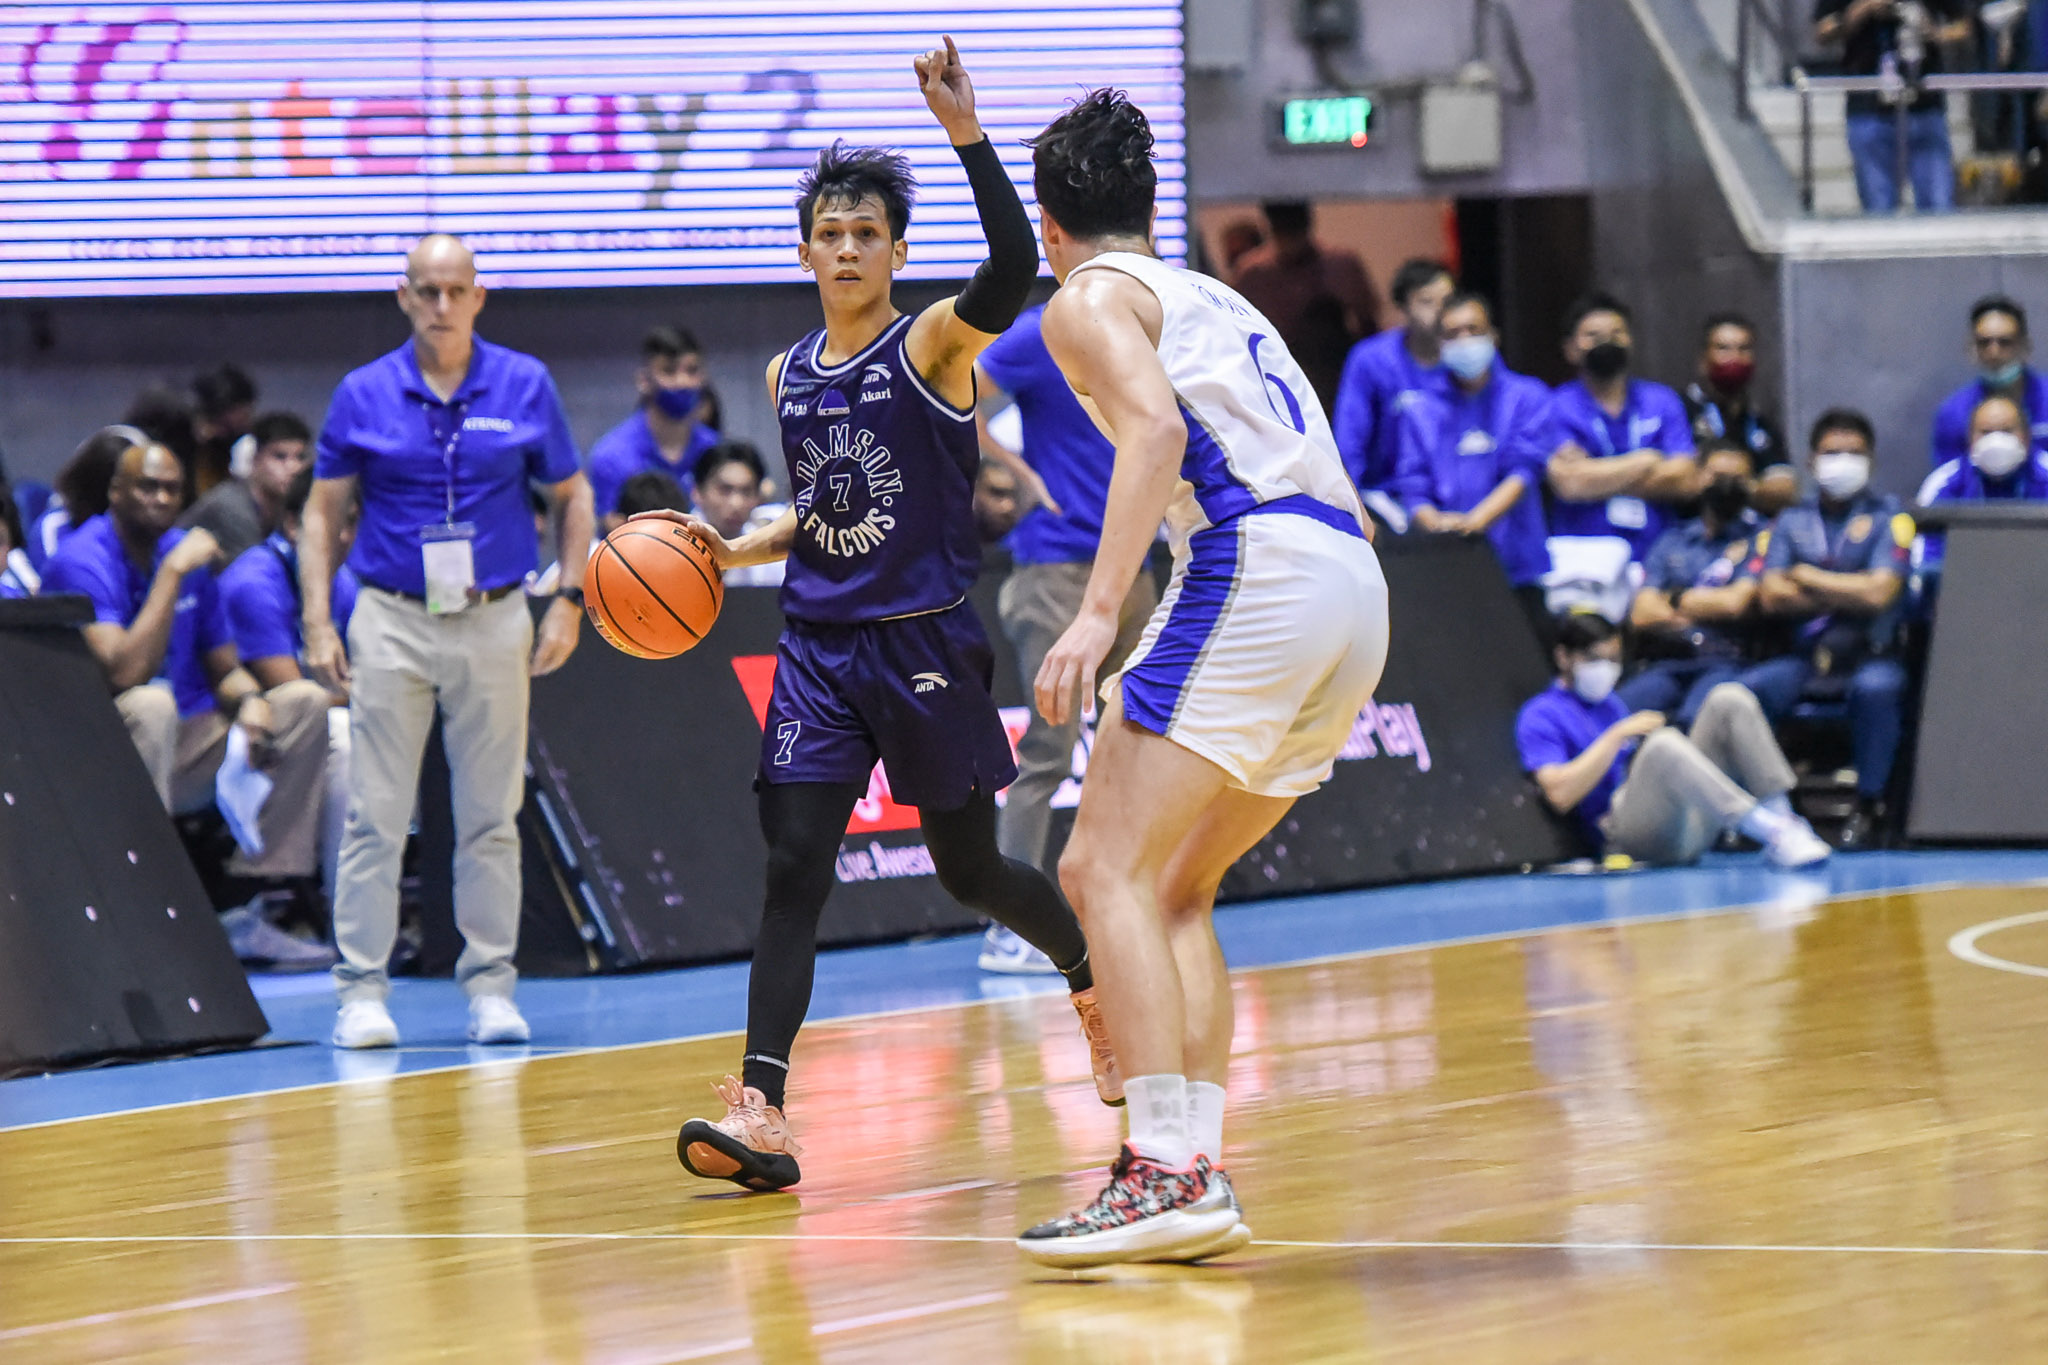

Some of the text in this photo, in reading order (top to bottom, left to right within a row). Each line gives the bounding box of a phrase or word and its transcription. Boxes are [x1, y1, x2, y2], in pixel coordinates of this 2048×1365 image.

[859, 387, 893, 404] Akari
[1247, 332, 1307, 436] 6
[829, 473, 852, 512] 7
[803, 507, 896, 558] FALCONS
[914, 680, 935, 694] ANTA
[773, 720, 801, 766] 7
